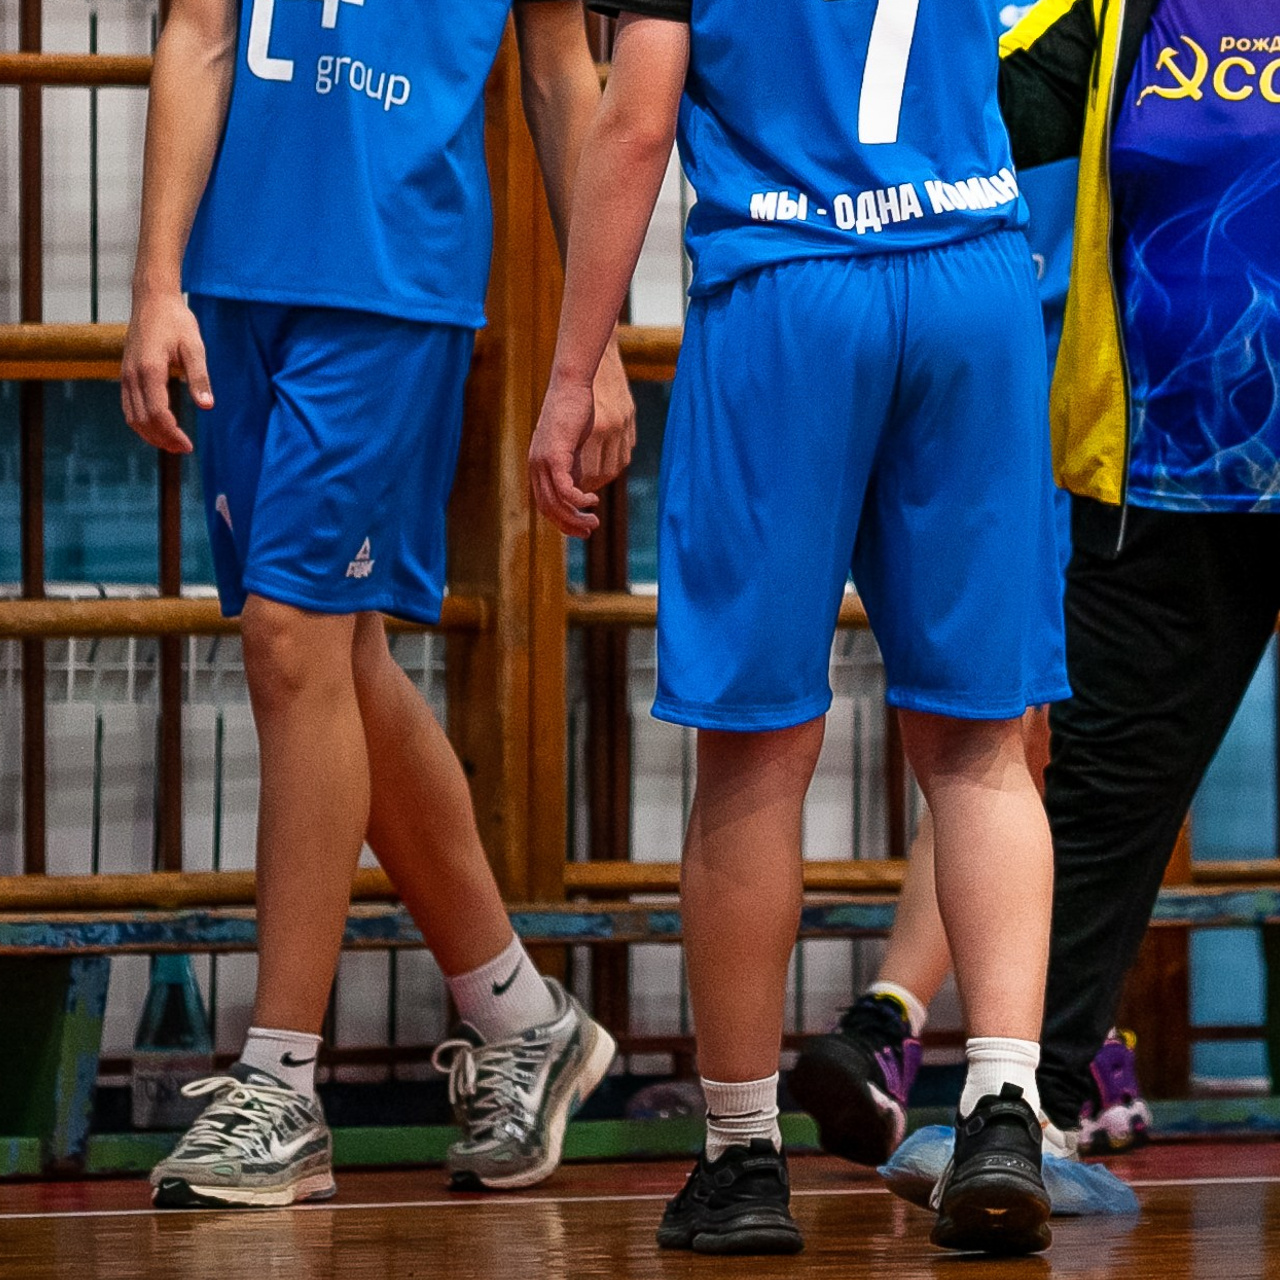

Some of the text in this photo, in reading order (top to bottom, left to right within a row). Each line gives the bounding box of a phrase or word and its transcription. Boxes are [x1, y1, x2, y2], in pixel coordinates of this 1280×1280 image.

[316, 55, 411, 111] group
[749, 190, 808, 222] МЫ
[832, 183, 923, 234] ОДНА
